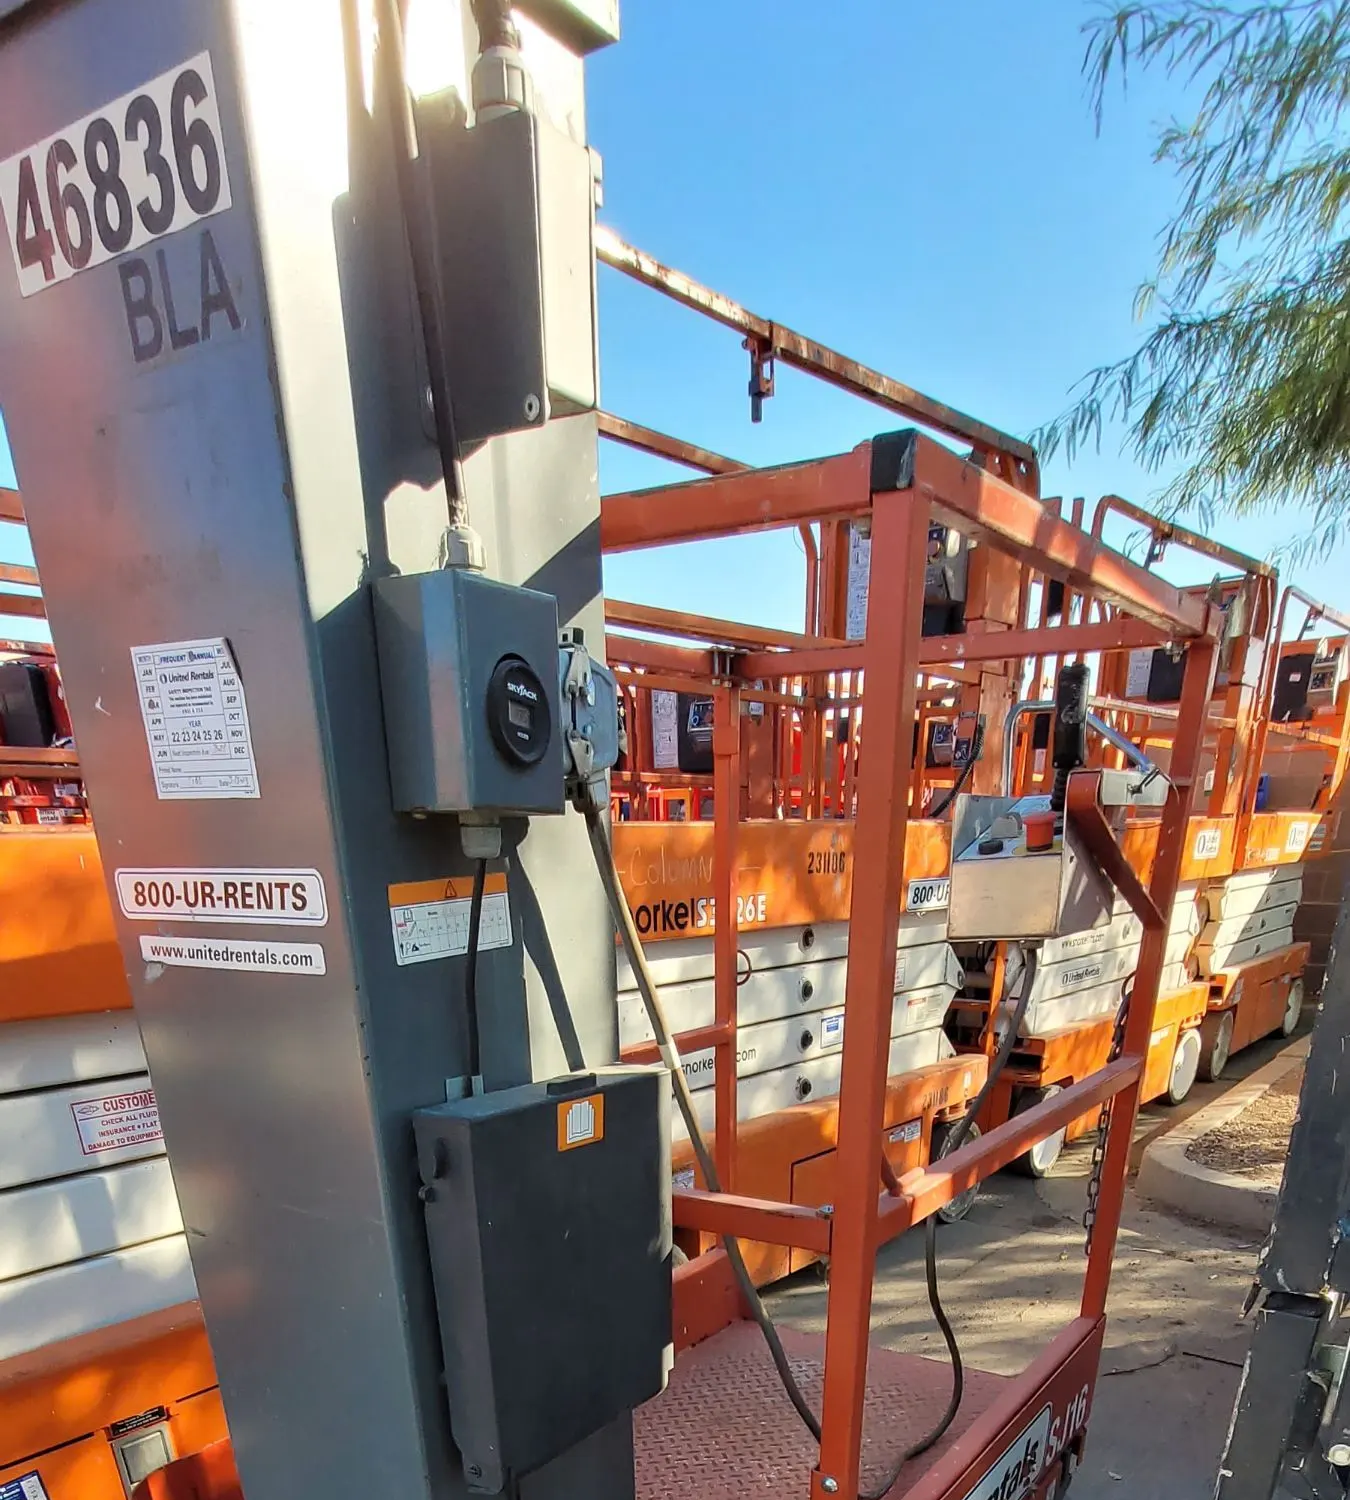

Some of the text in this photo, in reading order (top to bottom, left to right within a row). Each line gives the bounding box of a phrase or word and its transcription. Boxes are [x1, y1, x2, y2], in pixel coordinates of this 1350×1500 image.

[15, 68, 222, 282] 46836
[118, 229, 243, 364] BLA
[142, 669, 153, 677] JAN
[169, 669, 214, 683] United Rentals
[226, 696, 238, 704] SEP
[507, 682, 538, 701] SKYJACK
[189, 720, 202, 728] YEAR
[172, 729, 223, 742] 22 23 24 25 26
[234, 746, 245, 754] DEC
[807, 851, 846, 875] 231106
[133, 880, 308, 912] 800-UR-RENTS
[630, 894, 768, 934] orkel S326E
[150, 944, 314, 967] www.unitedrentals.com
[98, 1120, 158, 1137] INSURANCE FLAT
[101, 1118, 125, 1127] CHECK
[125, 1114, 138, 1122] ALL
[88, 1140, 116, 1151] DAMAGE
[127, 1130, 163, 1142] EQUIPMENT
[1045, 1383, 1089, 1467] SJ16
